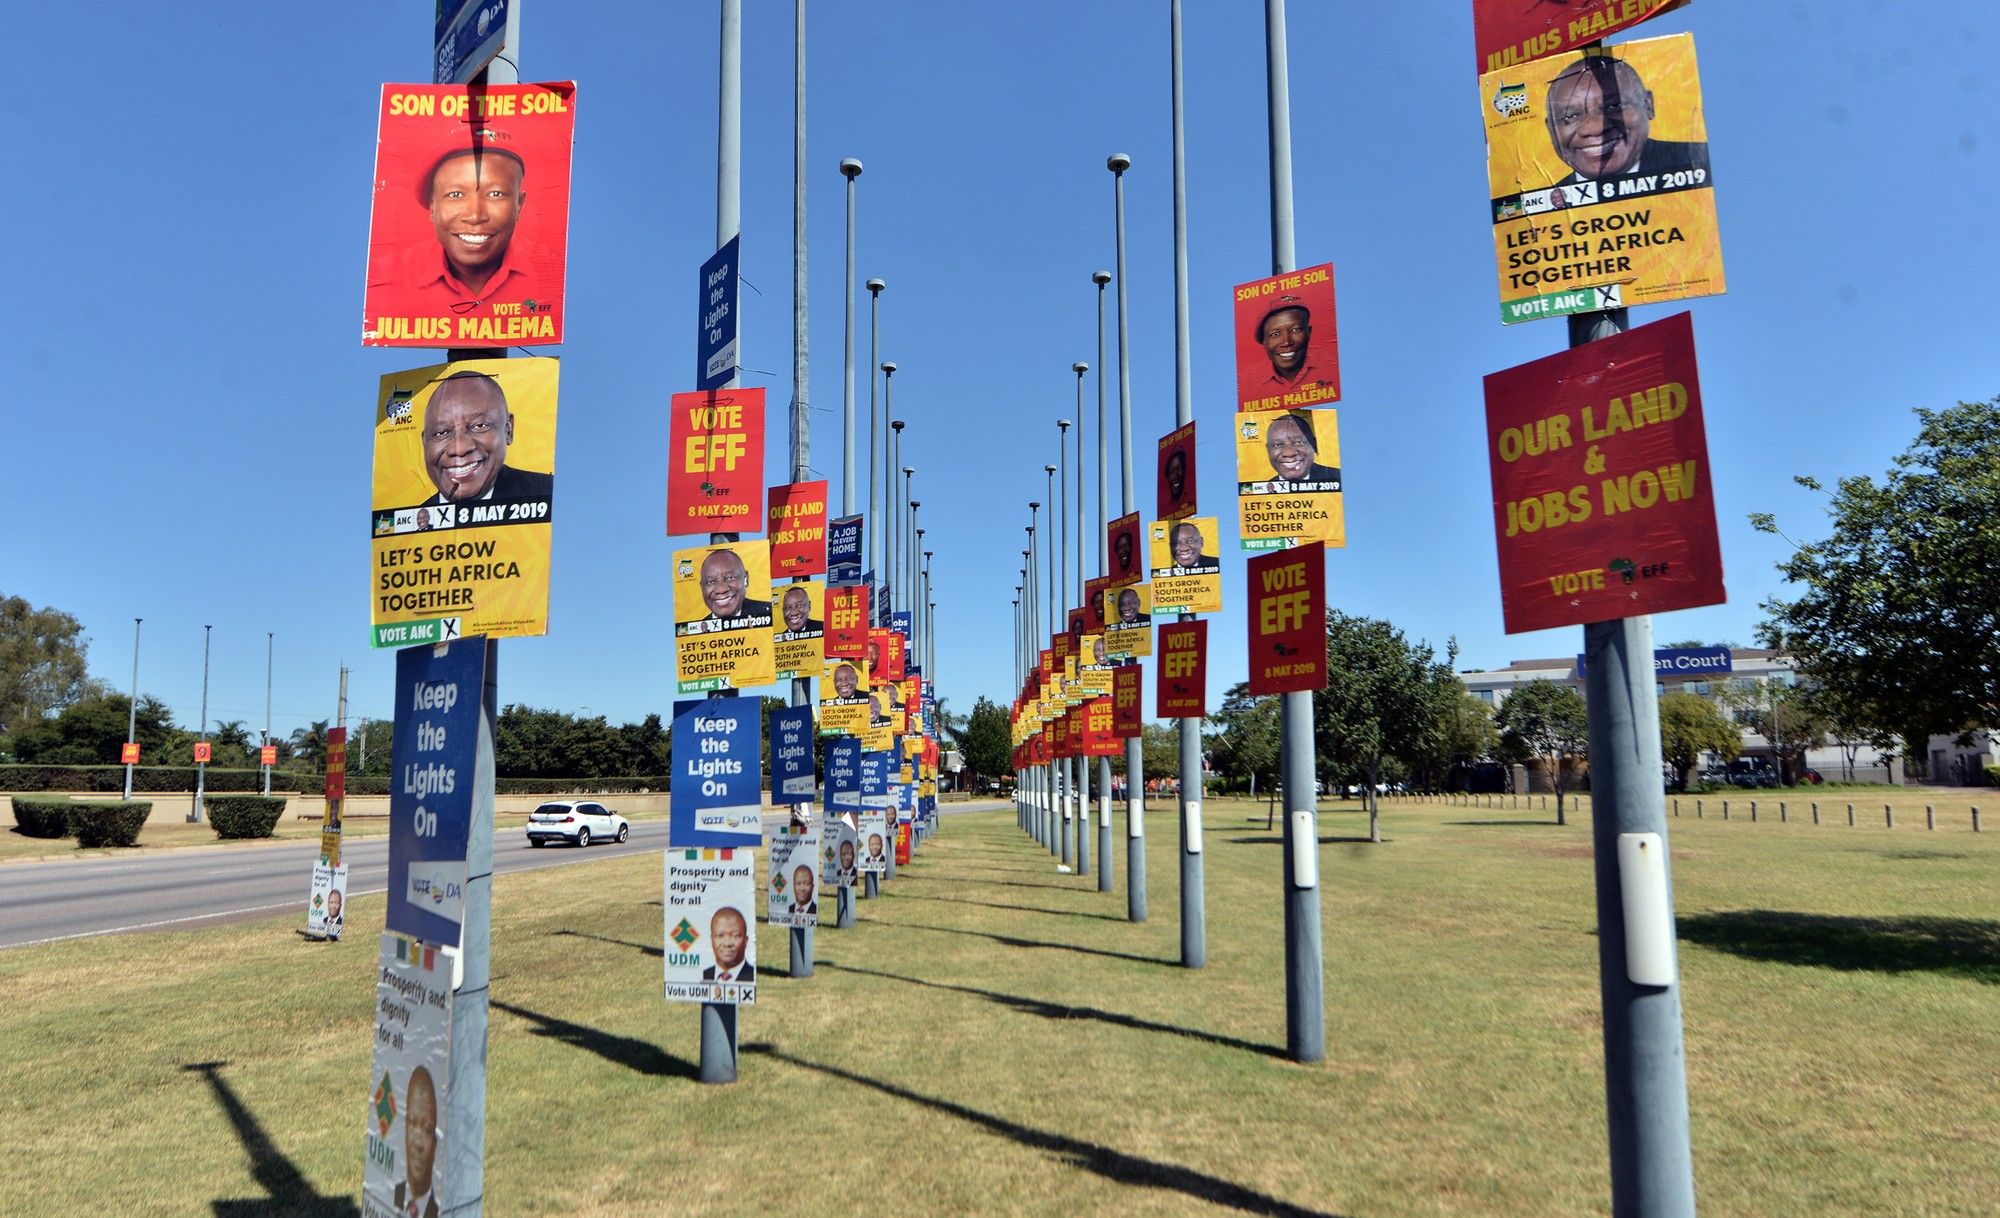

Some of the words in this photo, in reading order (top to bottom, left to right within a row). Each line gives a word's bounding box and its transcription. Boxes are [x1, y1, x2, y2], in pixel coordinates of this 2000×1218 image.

[1487, 28, 1562, 73] JULIUS
[1568, 0, 1662, 42] MALEM
[389, 94, 435, 116] SON
[440, 95, 470, 117] OF
[475, 94, 516, 115] THE
[519, 92, 567, 114] SOIL
[1508, 106, 1530, 118] ANC
[1602, 184, 1614, 198] 8
[1618, 176, 1658, 196] MAY
[1662, 168, 1706, 187] 2019
[1524, 197, 1543, 208] ANC
[1507, 224, 1563, 249] LET'S
[1571, 210, 1651, 236] GROW
[1508, 243, 1588, 270] SOUTH
[1598, 227, 1685, 254] AFRICA
[708, 264, 728, 289] Keep
[1509, 256, 1632, 289] TOGETHER
[1237, 286, 1260, 302] SON
[1262, 282, 1278, 295] OF
[1280, 276, 1301, 292] THE
[1303, 270, 1330, 286] SOIL
[711, 286, 724, 306] the
[492, 302, 521, 316] VOTE
[1510, 300, 1549, 317] VOTE
[1554, 294, 1585, 310] ANC
[704, 302, 728, 330] Lights
[374, 317, 451, 341] JULIUS
[458, 315, 556, 340] MALEMA
[710, 327, 722, 344] On
[1244, 396, 1280, 412] JULIUS
[1284, 386, 1336, 406] MALEMA
[395, 416, 412, 426] ANC
[690, 406, 743, 431] VOTE
[1499, 414, 1572, 462] OUR
[1581, 382, 1688, 442] LAND
[685, 434, 747, 474] EFF
[1583, 445, 1606, 476] &
[1291, 482, 1298, 492] 8
[1299, 482, 1318, 492] MAY
[1319, 482, 1340, 490] 2019
[1244, 501, 1272, 512] LET'S
[1276, 500, 1314, 510] GROW
[1506, 485, 1592, 538] JOBS
[1602, 459, 1696, 516] NOW
[458, 508, 469, 524] 8
[472, 504, 507, 522] MAY
[509, 502, 548, 520] 2019
[688, 506, 696, 517] 8
[698, 504, 721, 516] MAY
[722, 504, 750, 516] 2019
[770, 504, 792, 520] OUR
[794, 501, 824, 517] LAND
[1245, 512, 1284, 522] SOUTH
[1288, 510, 1328, 521] AFRICA
[396, 516, 412, 526] ANC
[792, 517, 801, 528] &
[1246, 522, 1304, 534] TOGETHER
[769, 529, 795, 546] JOBS
[797, 526, 824, 542] NOW
[833, 530, 840, 538] A
[841, 526, 857, 536] JOB
[839, 536, 856, 544] EVERY
[832, 543, 856, 554] HOME
[1244, 540, 1265, 548] VOTE
[1266, 538, 1282, 548] ANC
[381, 546, 423, 568] LET'S
[429, 540, 496, 561] GROW
[780, 558, 797, 568] VOTE
[380, 568, 442, 590] SOUTH
[448, 562, 520, 584] AFRICA
[1262, 562, 1306, 592] VOTE
[1549, 568, 1606, 596] VOTE
[1642, 562, 1670, 578] EFF
[1155, 588, 1180, 596] SOUTH
[1183, 586, 1210, 594] AFRICA
[1156, 594, 1194, 603] TOGETHER
[380, 588, 473, 613] TOGETHER
[832, 594, 858, 608] VOTE
[831, 609, 860, 630] EFF
[1260, 590, 1310, 636] EFF
[723, 620, 730, 630] 8
[730, 616, 749, 628] MAY
[751, 616, 771, 626] 2019
[380, 626, 406, 644] VOTE
[408, 624, 434, 640] ANC
[1168, 632, 1196, 650] VOTE
[681, 642, 706, 652] LET'S
[709, 637, 745, 649] GROW
[786, 644, 808, 652] GROW
[682, 652, 718, 664] SOUTH
[720, 648, 760, 660] AFRICA
[792, 650, 816, 660] AFRICA
[1675, 652, 1726, 669] Court
[682, 662, 736, 676] TOGETHER
[1165, 650, 1198, 678] EFF
[1264, 668, 1272, 678] 8
[1272, 665, 1292, 678] MAY
[1293, 662, 1316, 674] 2019
[682, 682, 700, 692] VOTE
[701, 681, 715, 690] ANC
[1118, 673, 1136, 686] VOTE
[413, 682, 458, 714] Keep
[1117, 688, 1136, 708] EFF
[1089, 703, 1112, 714] VOTE
[694, 717, 738, 734] Keep
[780, 720, 802, 731] Keep
[1088, 714, 1112, 732] EFF
[417, 720, 446, 752] the
[784, 733, 799, 744] the
[701, 737, 730, 754] the
[778, 746, 805, 760] Lights
[833, 747, 852, 756] Keep
[688, 758, 742, 778] Lights
[786, 760, 798, 772] On
[836, 758, 848, 766] the
[861, 760, 879, 768] Keep
[830, 768, 853, 778] Lights
[864, 768, 876, 776] the
[404, 762, 456, 800] Lights
[702, 780, 728, 797] On
[836, 779, 847, 788] On
[414, 806, 437, 838] On
[701, 816, 724, 825] VOTE
[742, 815, 758, 824] DA
[670, 866, 726, 878] Prosperity
[728, 867, 749, 876] and
[446, 882, 461, 899] DA
[670, 882, 707, 892] dignity
[670, 896, 686, 905] for
[688, 896, 702, 905] all
[770, 895, 788, 903] UDM
[669, 953, 700, 966] UDM
[383, 966, 427, 1004] Prosperity
[429, 988, 446, 1009] and
[666, 986, 686, 997] Vote
[688, 986, 709, 997] UDM
[380, 998, 410, 1028] dignity
[379, 1023, 390, 1044] for
[392, 1032, 404, 1050] all
[370, 1136, 394, 1173] UDM
